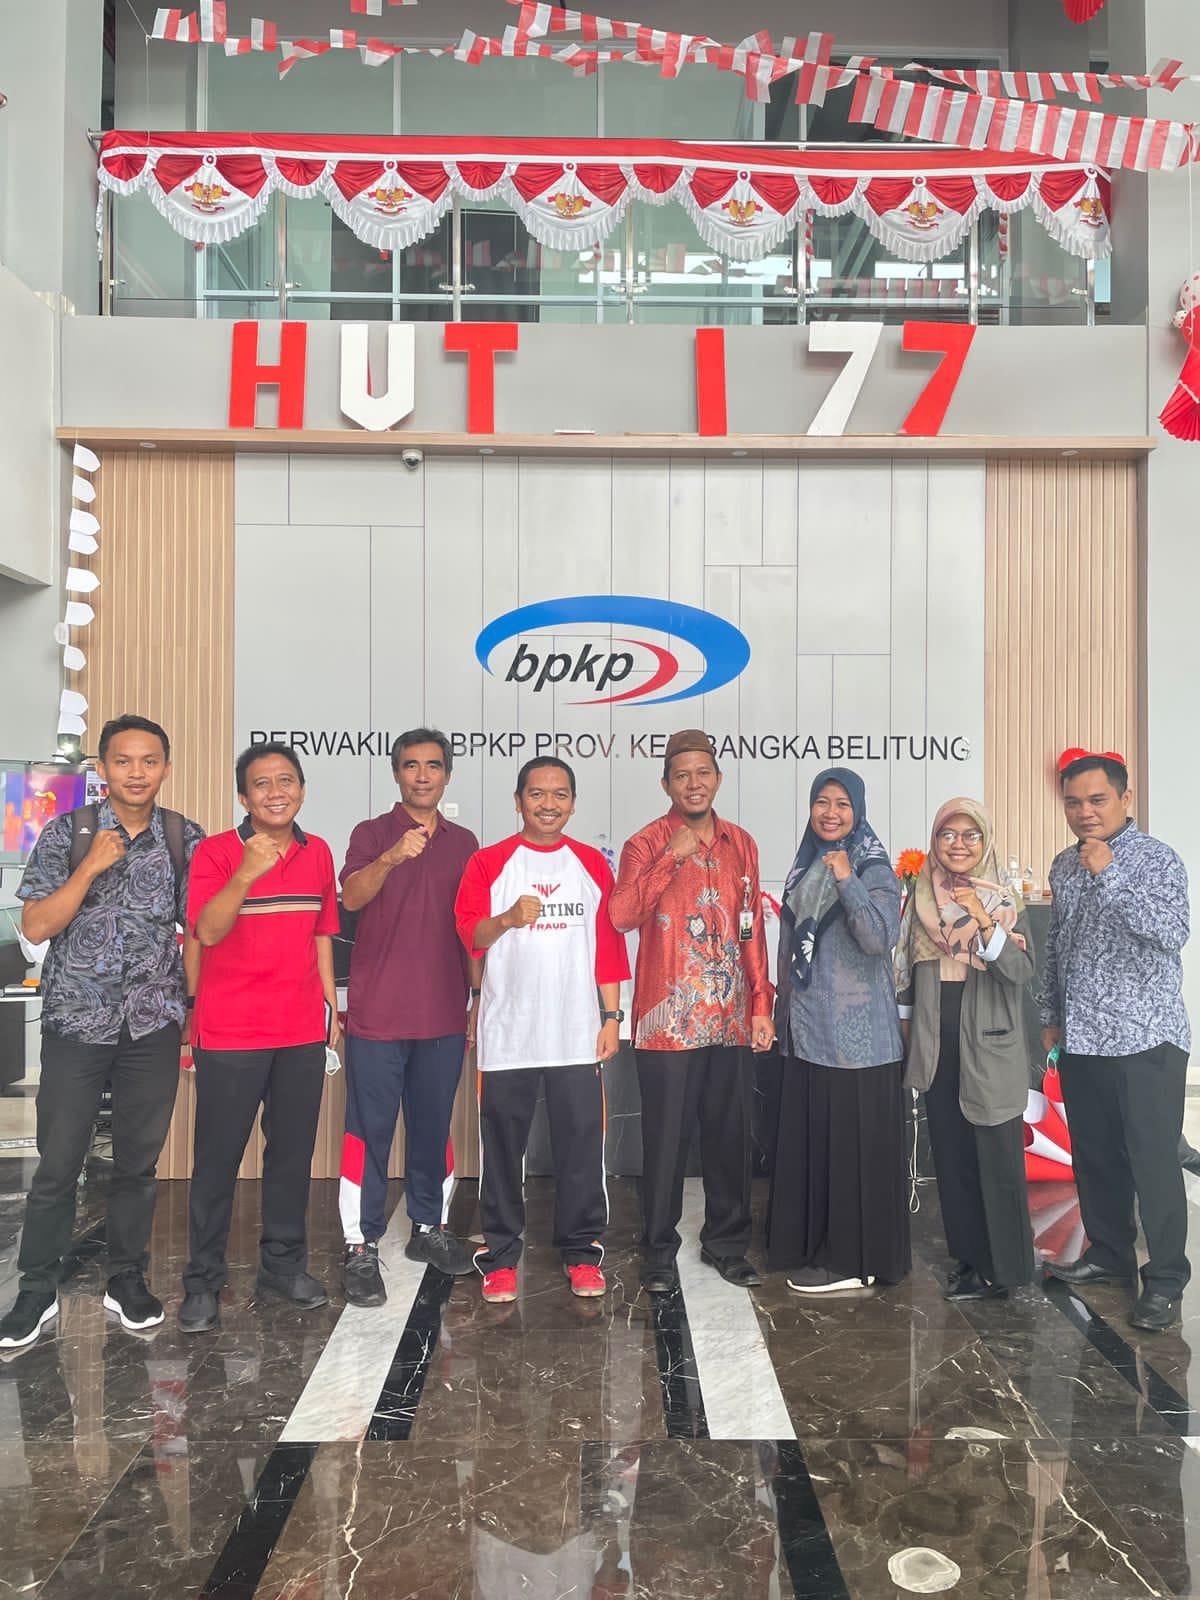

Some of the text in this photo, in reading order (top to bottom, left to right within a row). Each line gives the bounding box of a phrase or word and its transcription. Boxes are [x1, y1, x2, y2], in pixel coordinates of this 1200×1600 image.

[229, 322, 519, 434] HUT
[806, 321, 977, 436] 77
[505, 644, 634, 692] bpkp
[250, 731, 393, 756] PERWAKIL
[451, 733, 526, 757] BPKP
[535, 734, 620, 758] PROV.
[630, 734, 671, 758] KE
[827, 735, 970, 761] BELITUNG
